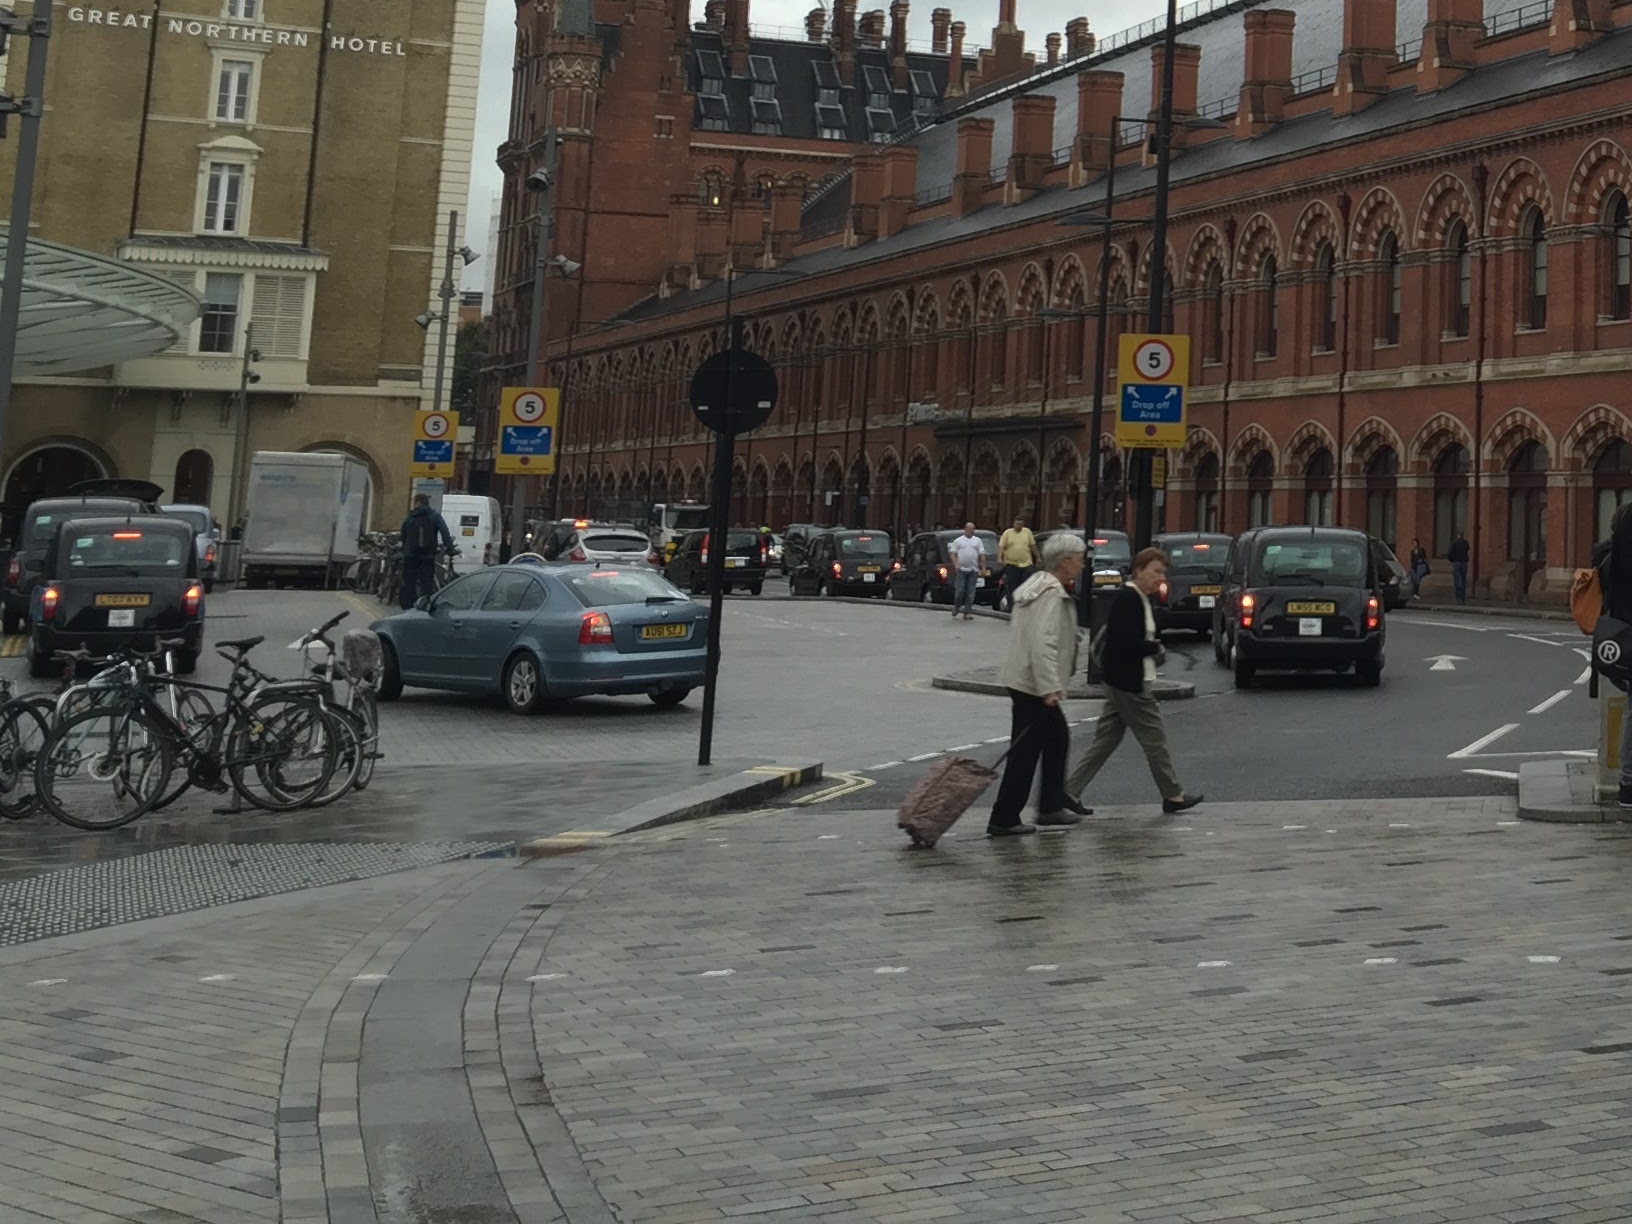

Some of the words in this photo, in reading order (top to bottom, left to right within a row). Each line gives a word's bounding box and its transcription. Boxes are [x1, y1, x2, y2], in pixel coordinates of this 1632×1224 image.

[68, 7, 152, 28] GREAT
[168, 19, 308, 47] NORTHERN
[330, 35, 406, 56] HOTEL
[1148, 352, 1161, 369] 5
[525, 401, 536, 414] 5
[1131, 400, 1155, 411] Drop
[1156, 400, 1170, 410] off
[1139, 410, 1161, 419] Area
[432, 421, 441, 431] 5
